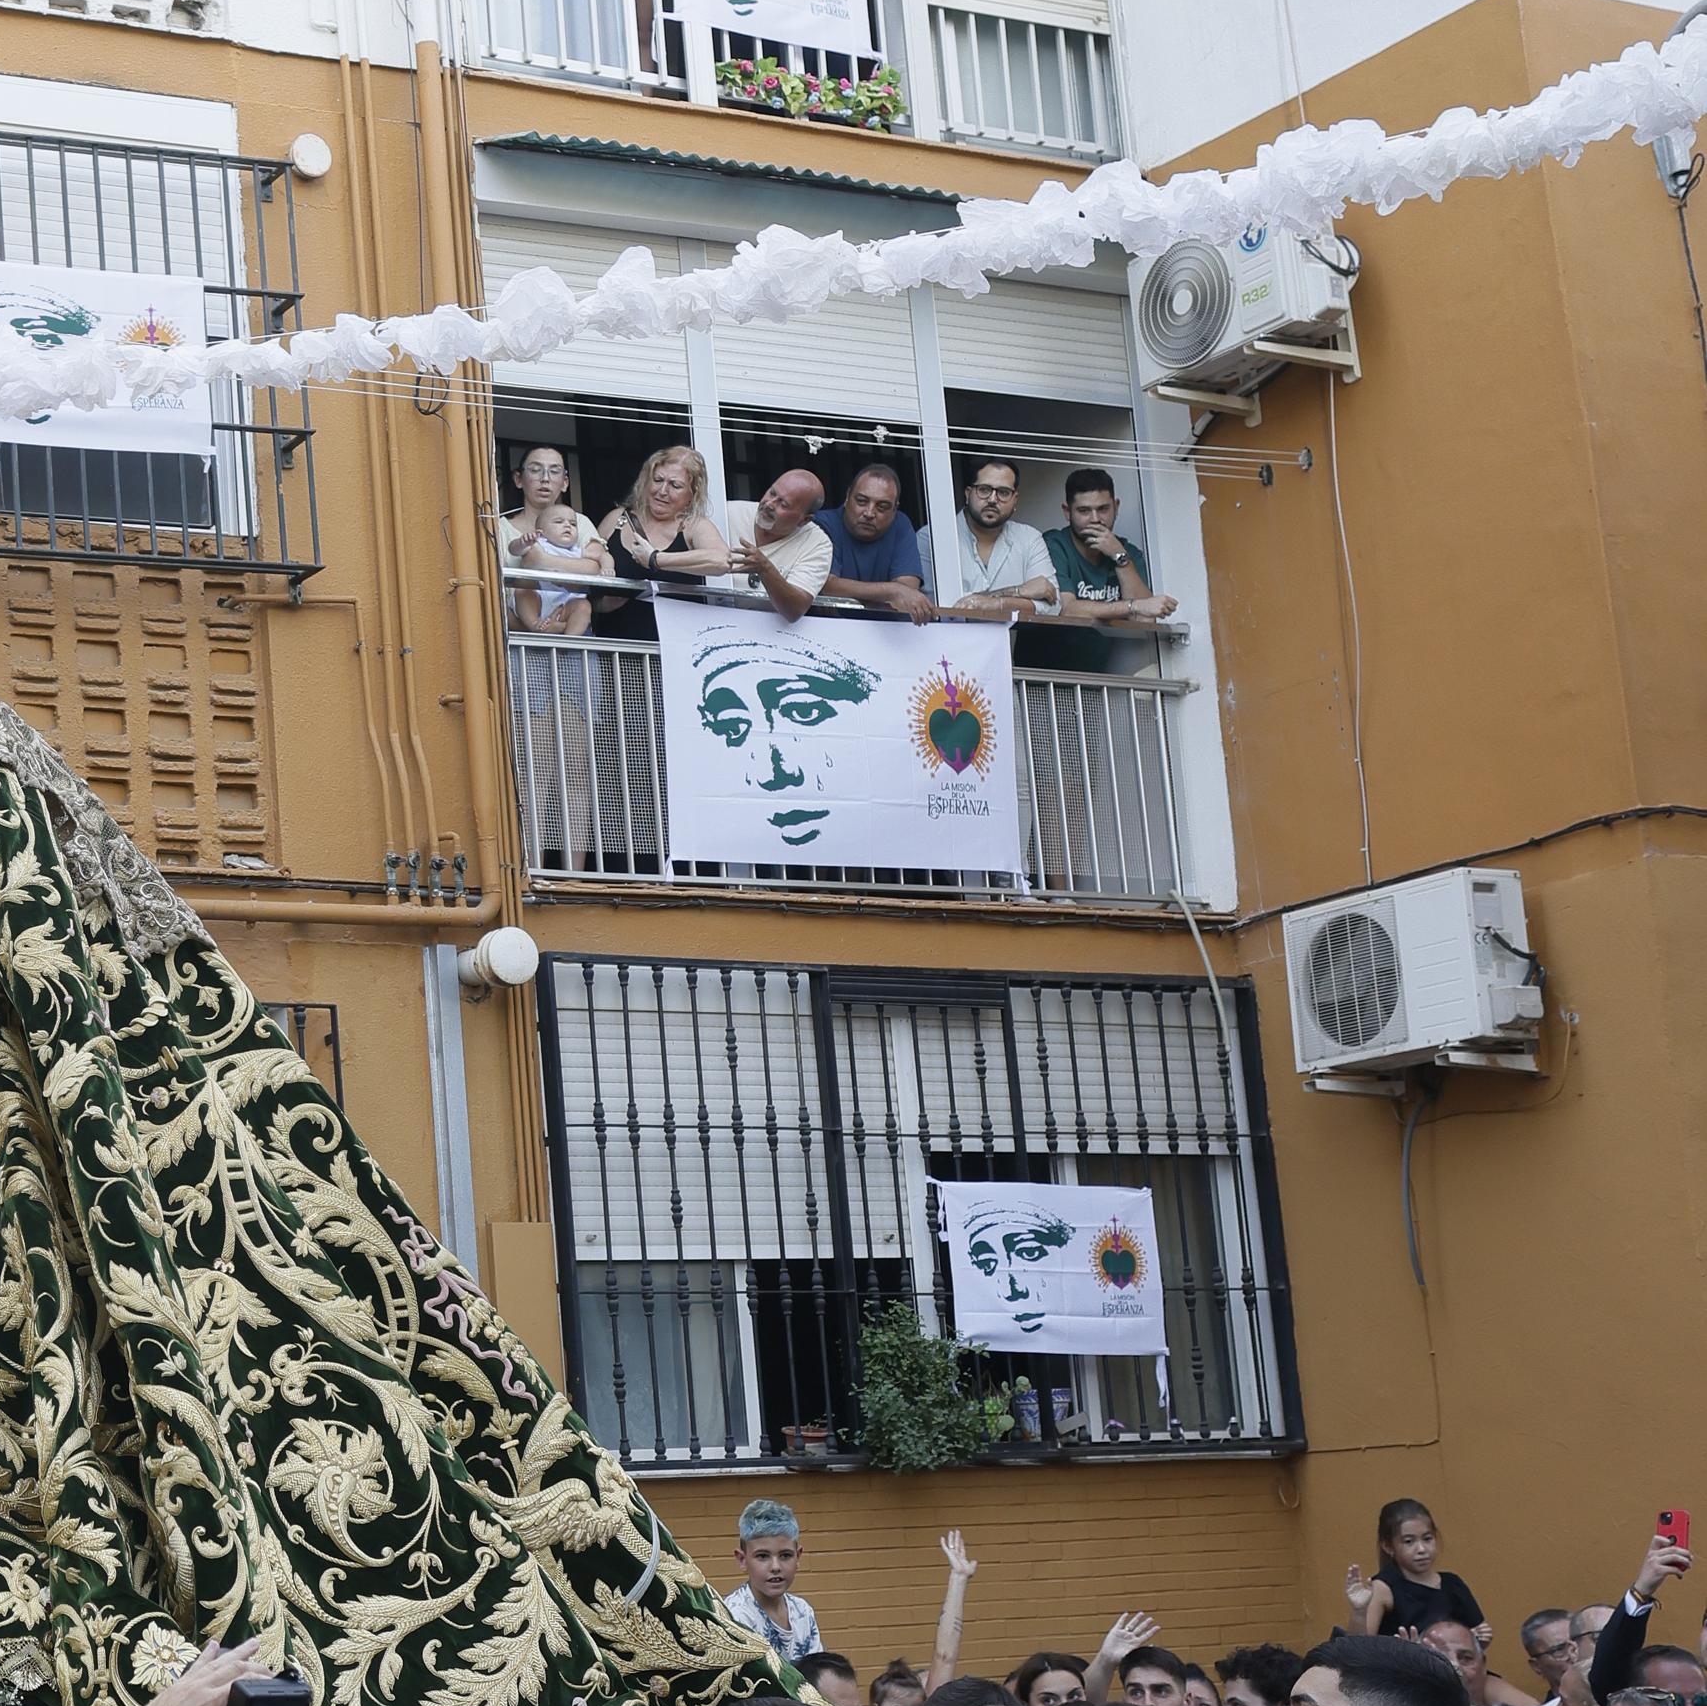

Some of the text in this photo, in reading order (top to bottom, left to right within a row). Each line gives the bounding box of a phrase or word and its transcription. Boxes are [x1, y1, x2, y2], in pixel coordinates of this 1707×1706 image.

[1241, 284, 1269, 307] R32
[940, 782, 977, 792] LA MISIÓN
[927, 794, 991, 820] ESPERANZA
